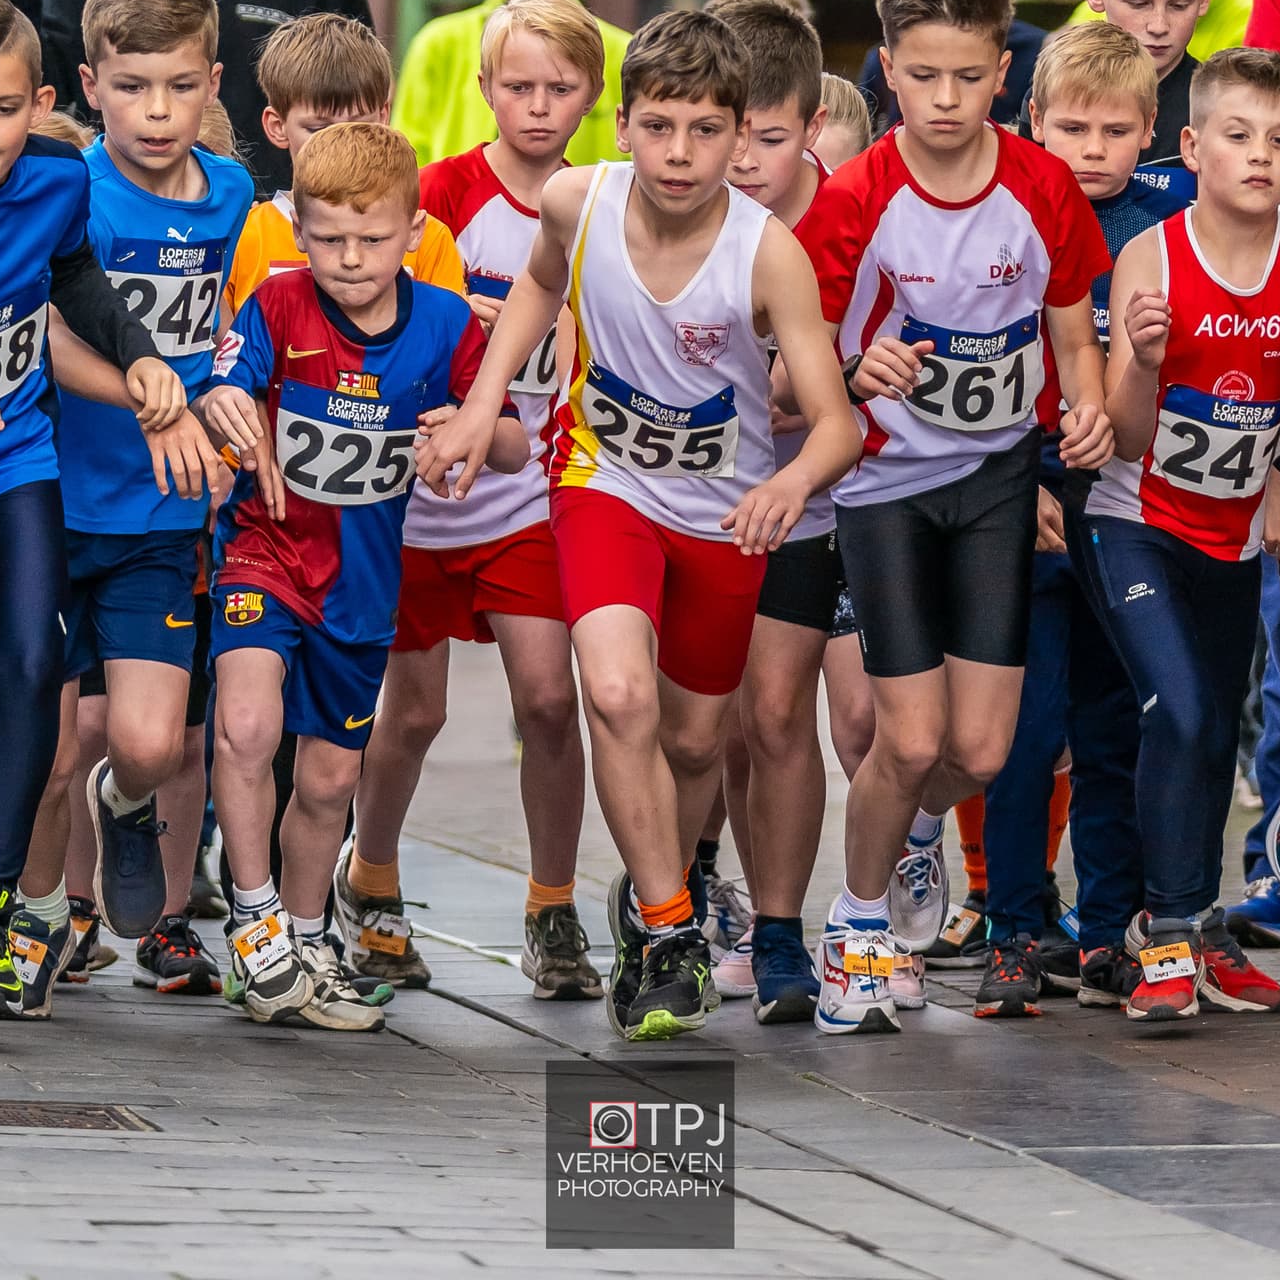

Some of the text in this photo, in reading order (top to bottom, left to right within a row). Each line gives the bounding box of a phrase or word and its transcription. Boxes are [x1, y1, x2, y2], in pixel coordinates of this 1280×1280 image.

[159, 247, 199, 260] LOPERS
[158, 257, 200, 269] COMPANY
[899, 273, 936, 284] Balans
[118, 276, 218, 346] 242
[951, 335, 997, 348] LOPERS
[950, 345, 997, 356] COMPANY
[977, 351, 1005, 363] TILBURG
[910, 352, 1025, 423] 261
[327, 396, 376, 414] LOPERS
[630, 399, 675, 423] COMPANY
[631, 393, 676, 418] LOPERS
[1213, 402, 1262, 417] LOPERS
[326, 406, 375, 423] COMPANY
[1212, 412, 1260, 424] COMPANY
[352, 421, 385, 431] TILBURG
[1239, 423, 1270, 431] TILBURG
[592, 398, 726, 470] 255
[283, 420, 417, 495] 225
[248, 925, 269, 944] 225
